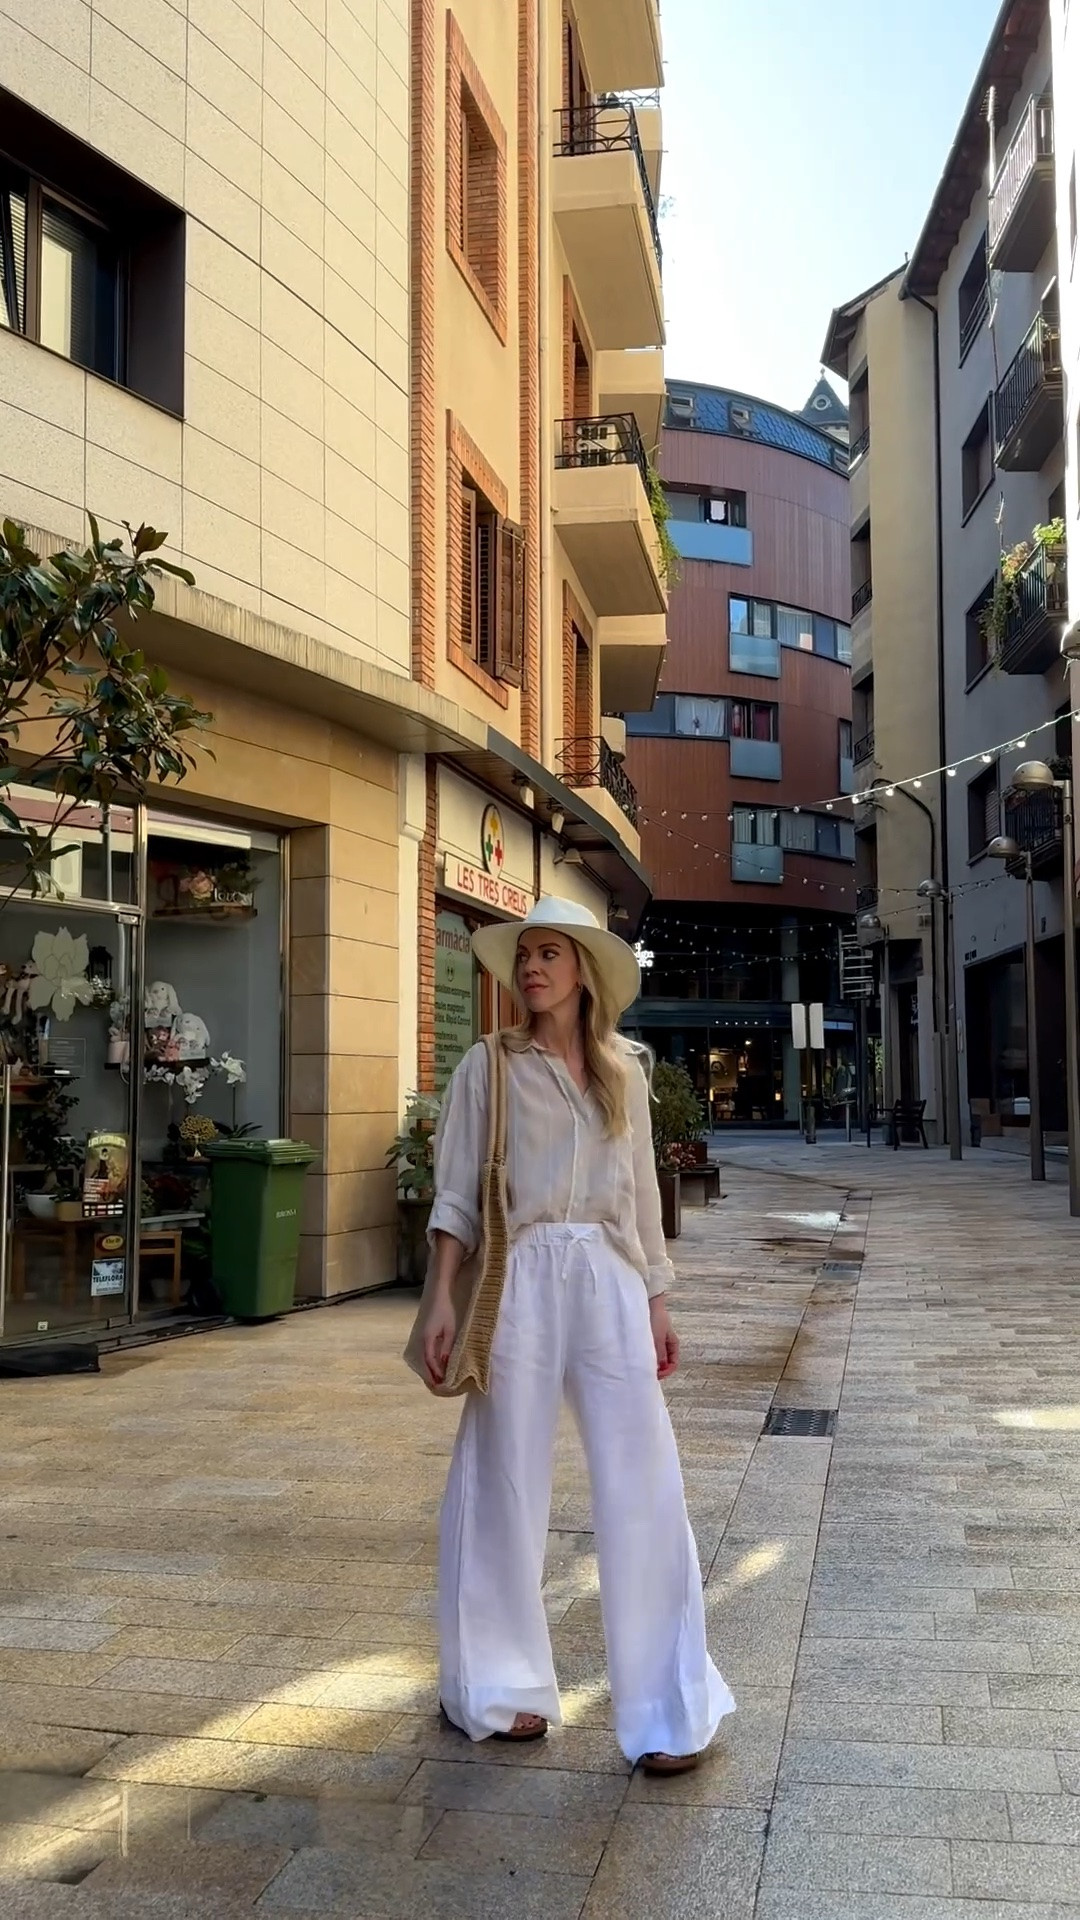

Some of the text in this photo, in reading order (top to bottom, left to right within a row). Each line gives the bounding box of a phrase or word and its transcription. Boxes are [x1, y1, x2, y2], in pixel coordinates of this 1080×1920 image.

[457, 863, 527, 915] LES TRES CREUS
[435, 928, 471, 953] armàcia
